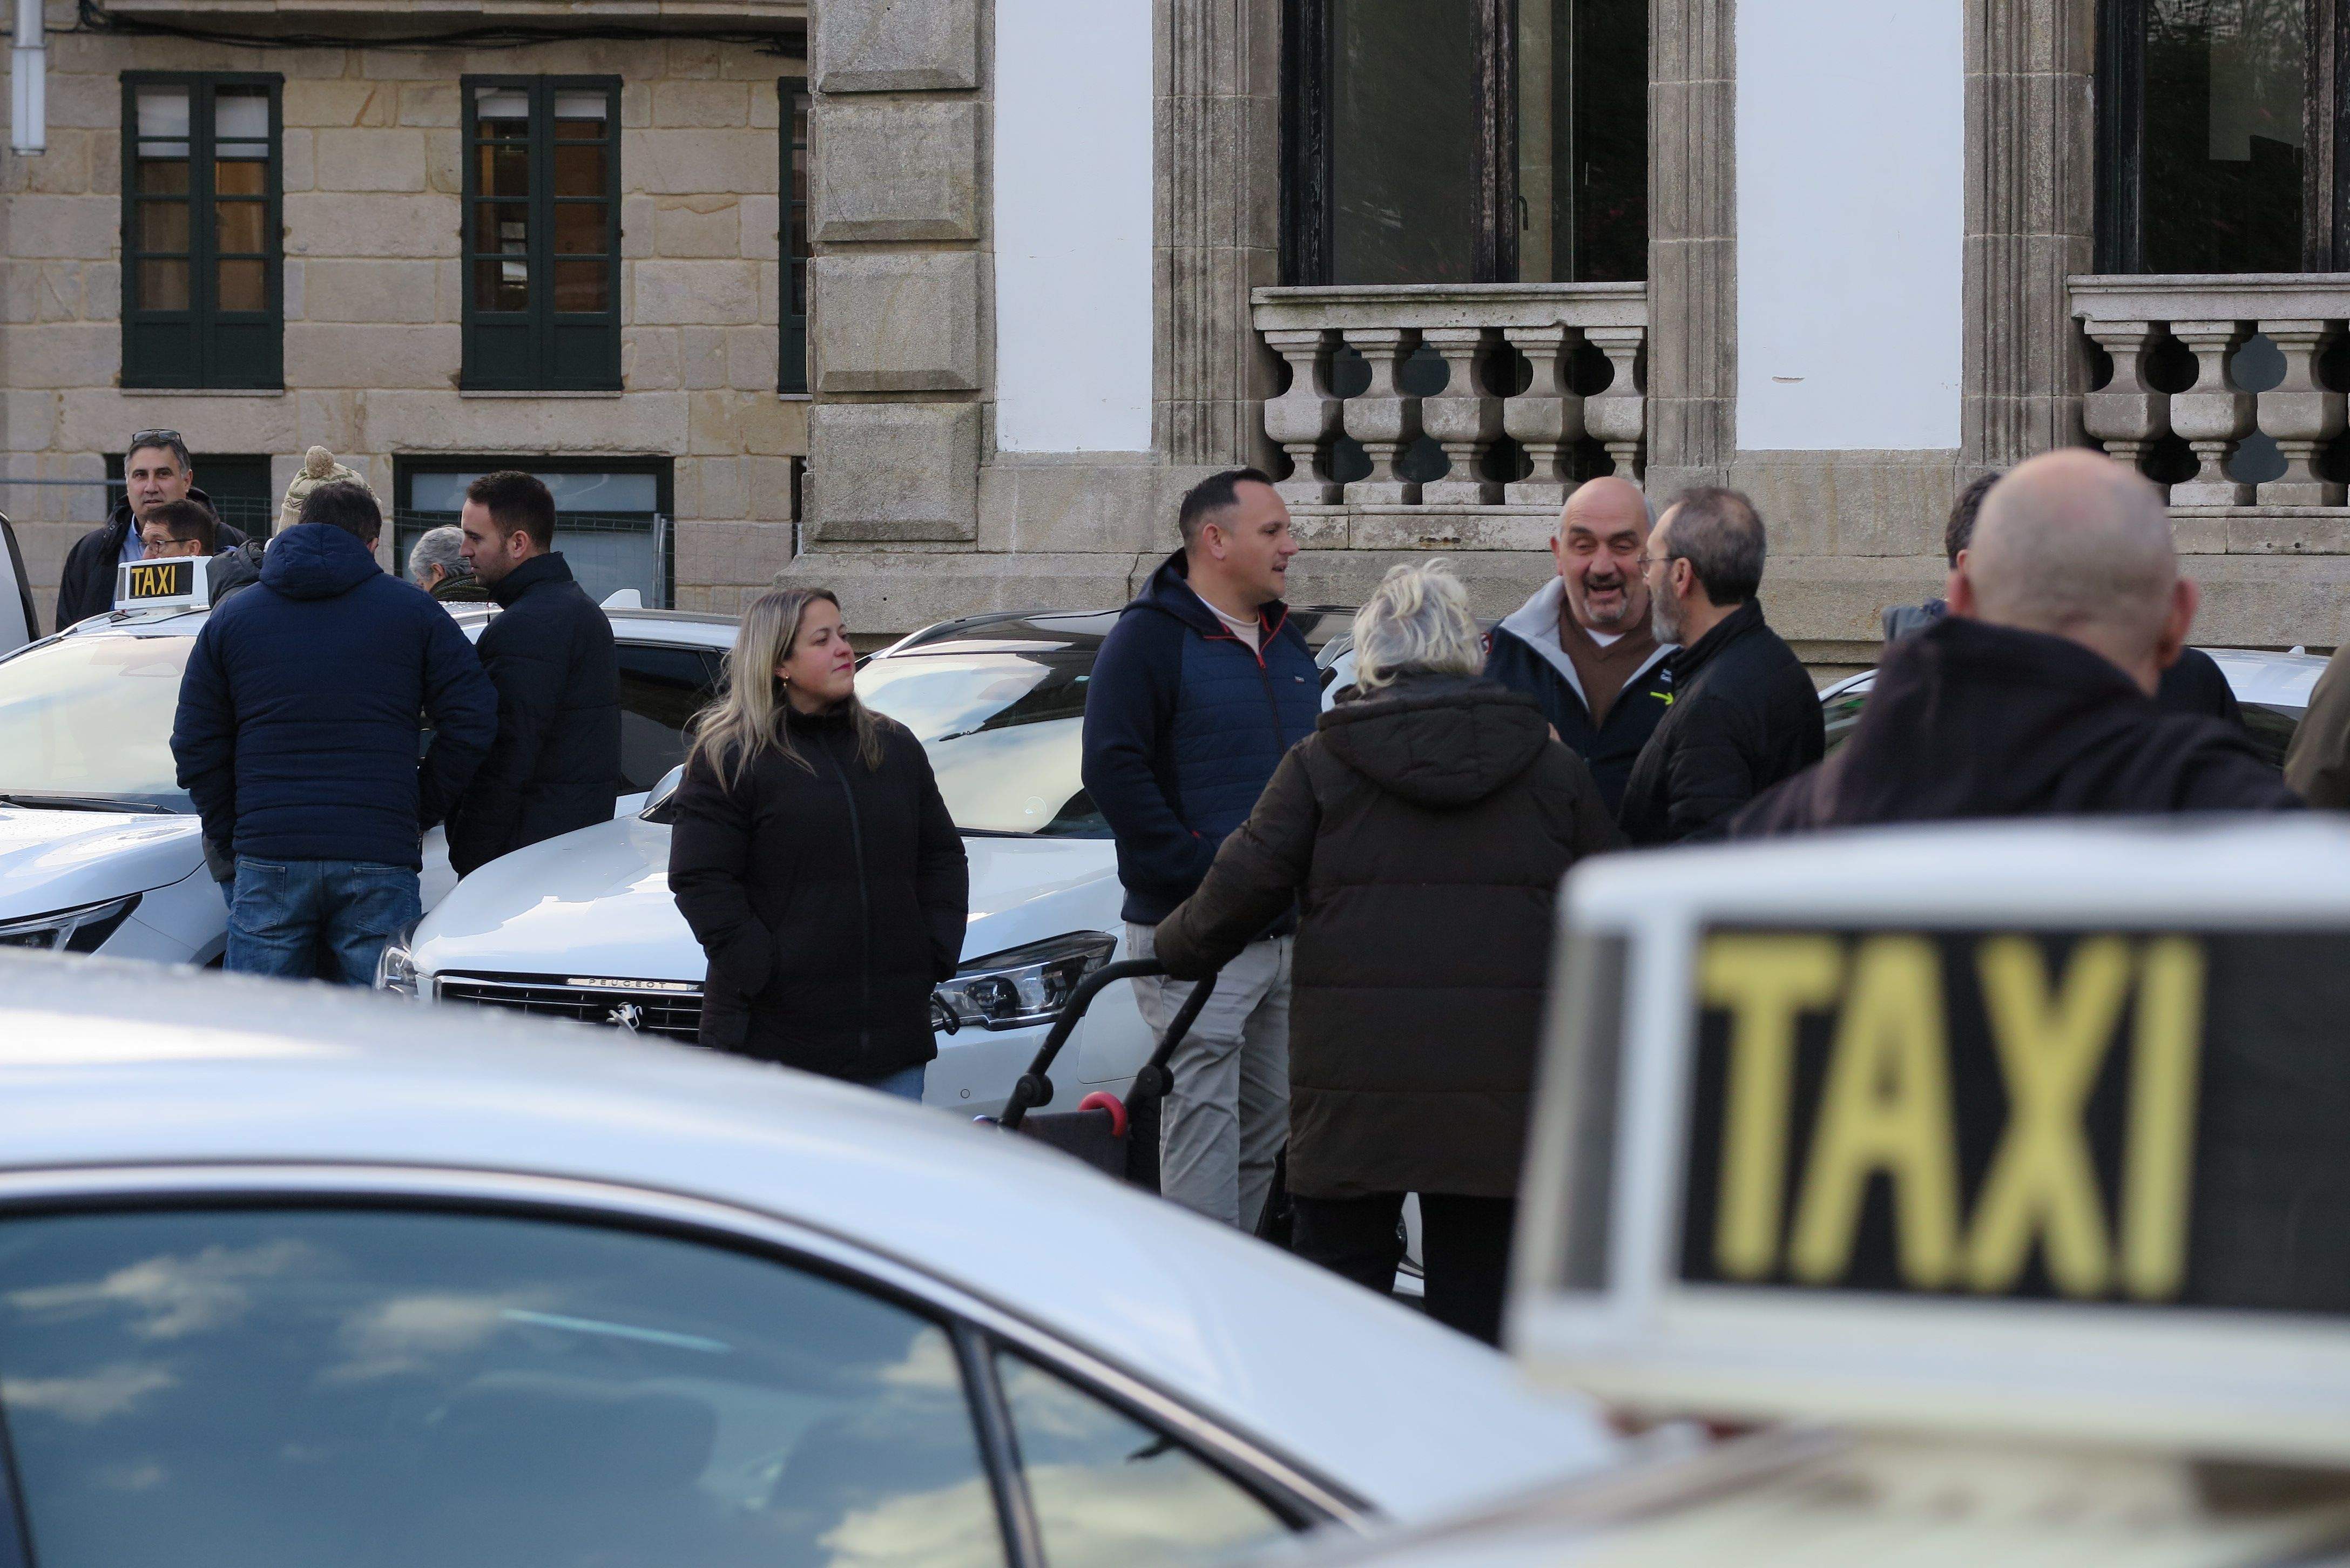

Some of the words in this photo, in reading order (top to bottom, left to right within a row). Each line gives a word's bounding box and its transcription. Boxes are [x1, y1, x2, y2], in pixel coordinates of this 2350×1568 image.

[131, 565, 175, 597] TAXI
[589, 978, 666, 989] PEUGEOT
[1698, 933, 2207, 1298] TAXI
